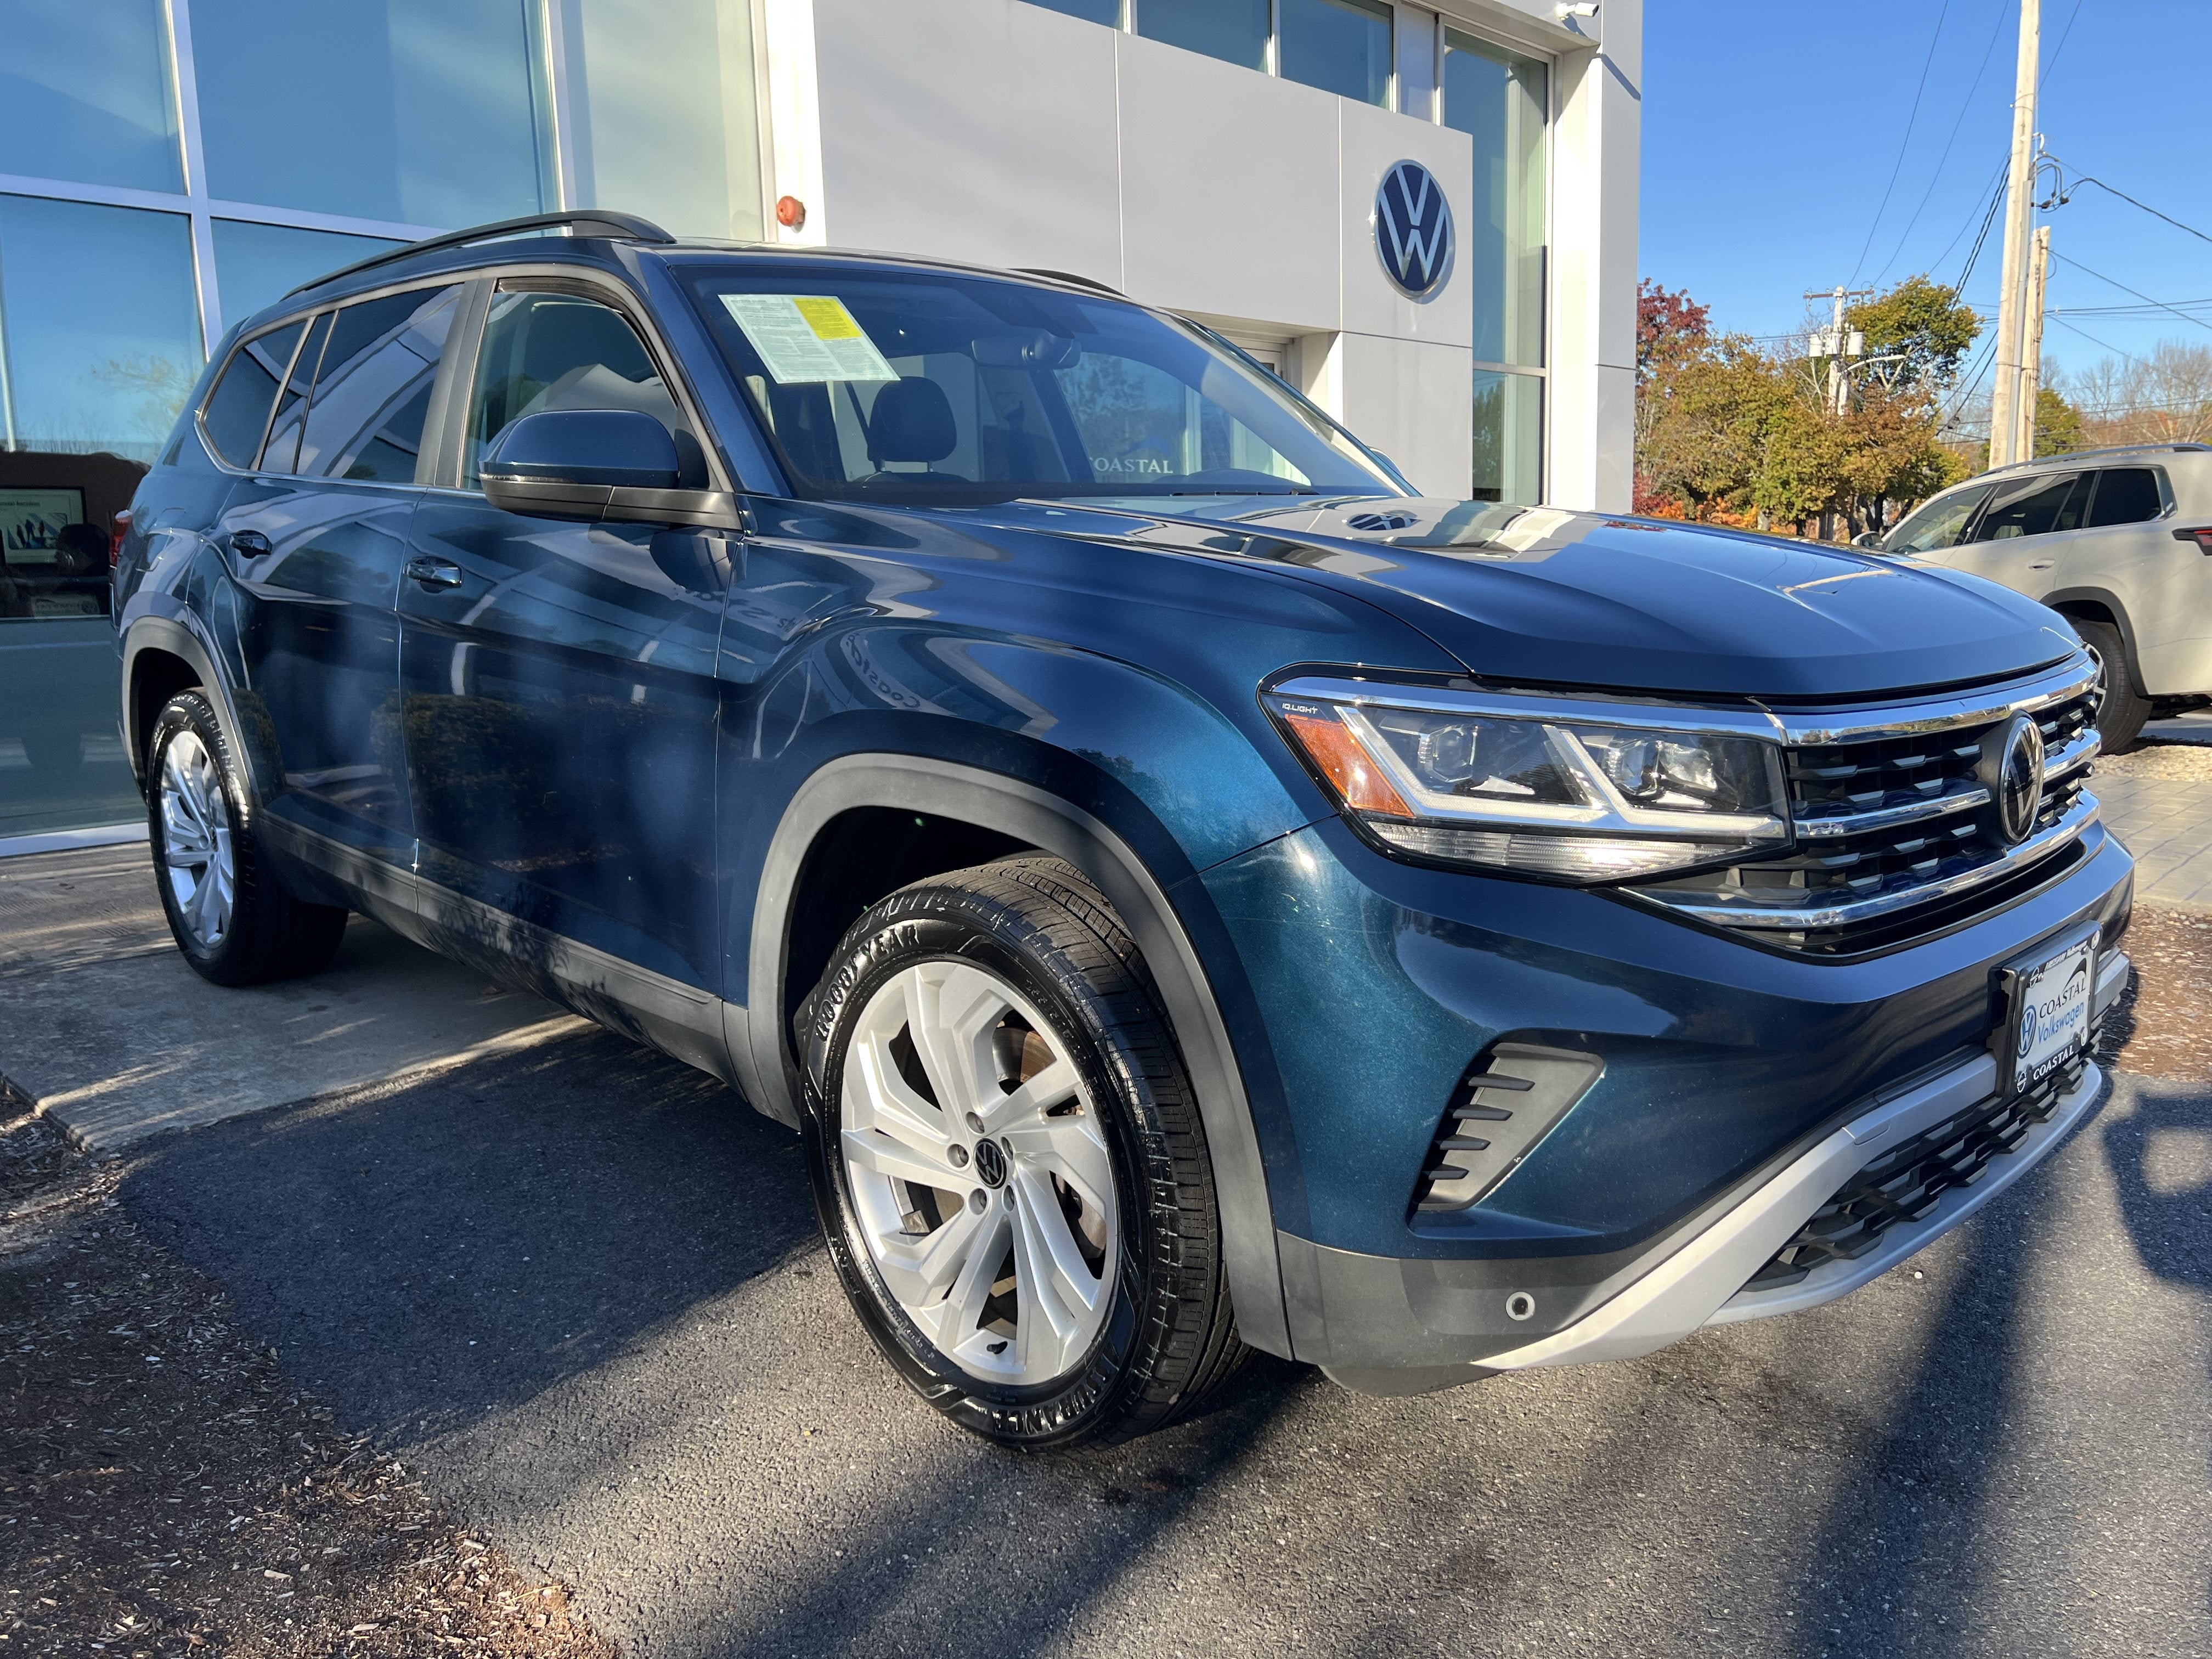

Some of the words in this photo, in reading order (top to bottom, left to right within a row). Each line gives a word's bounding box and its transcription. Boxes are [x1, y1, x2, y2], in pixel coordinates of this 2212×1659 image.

[1089, 457, 1173, 474] OASTAL
[1282, 702, 1318, 714] IQ.LIGHT
[2039, 977, 2086, 1019] COASTAL
[2038, 1002, 2084, 1046] Volkswagen
[2033, 1045, 2074, 1081] COASTAL
